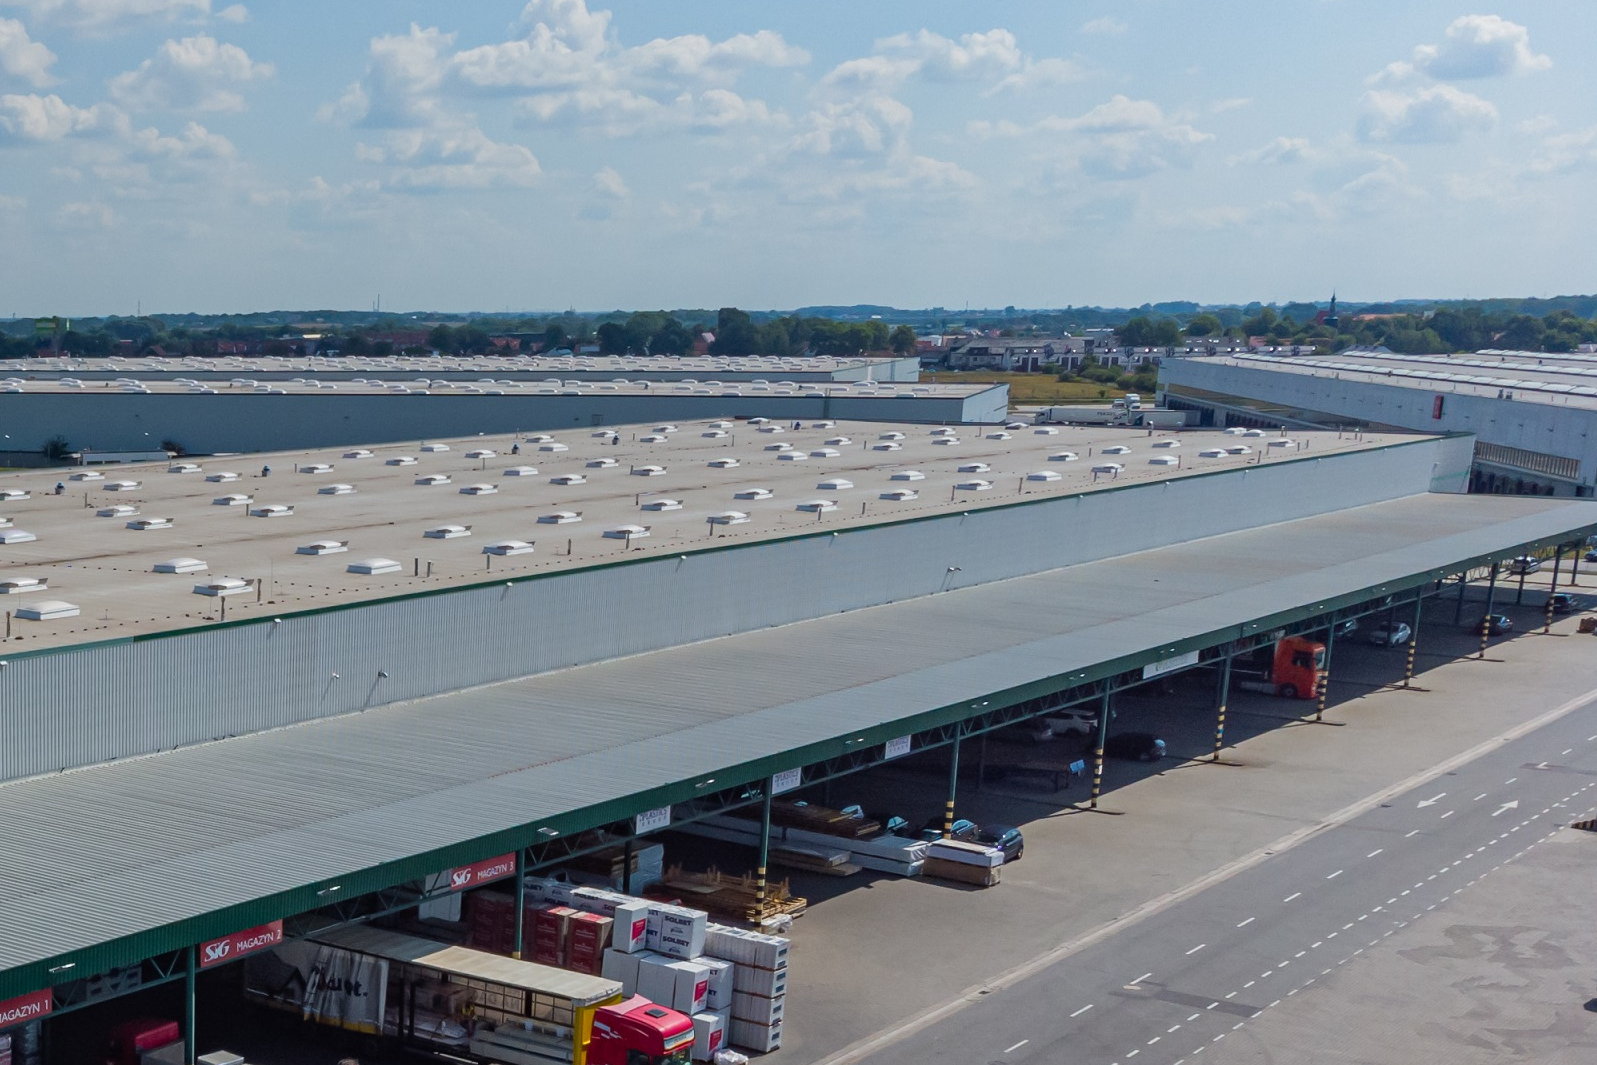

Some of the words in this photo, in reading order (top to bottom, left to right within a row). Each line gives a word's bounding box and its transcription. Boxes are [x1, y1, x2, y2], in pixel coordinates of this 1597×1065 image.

[452, 868, 472, 886] SIG
[477, 863, 508, 880] MAGAZYN
[509, 861, 515, 871] 3
[665, 914, 692, 926] SOLBET
[204, 940, 230, 962] SIG
[236, 931, 274, 952] MAGAZYN
[275, 929, 282, 940] 2
[662, 935, 690, 947] SOLBET
[44, 999, 49, 1010] 1
